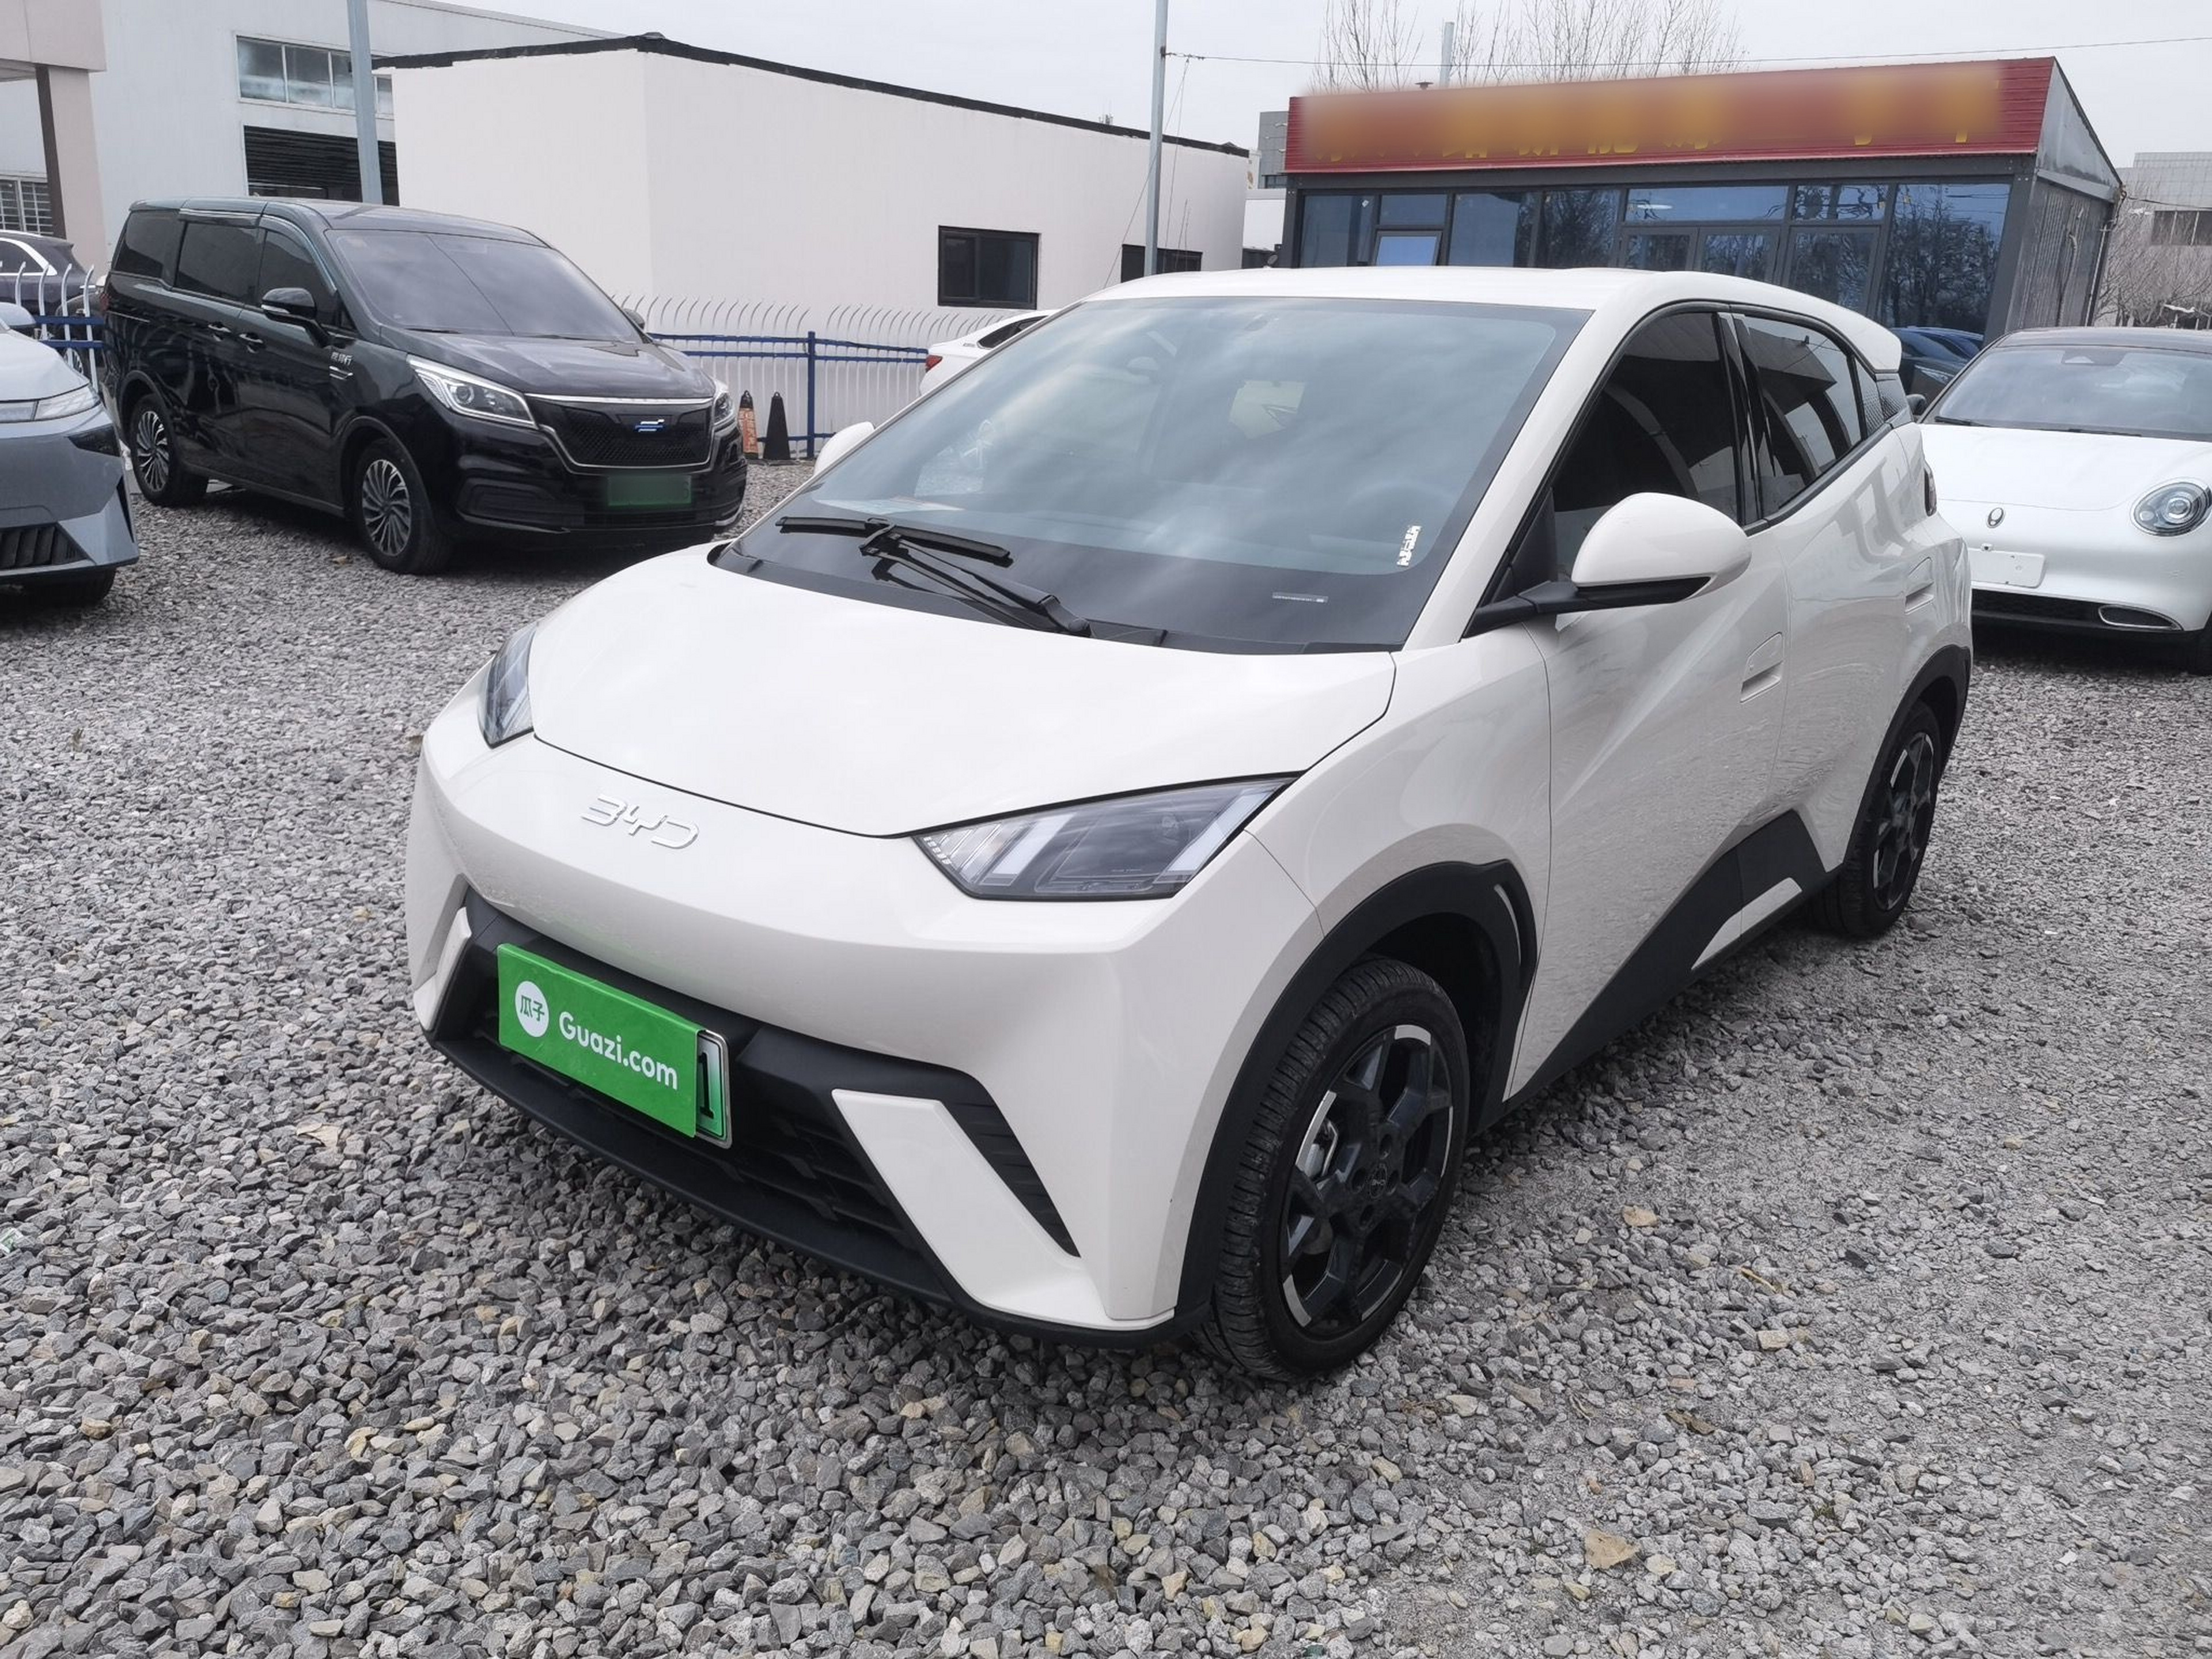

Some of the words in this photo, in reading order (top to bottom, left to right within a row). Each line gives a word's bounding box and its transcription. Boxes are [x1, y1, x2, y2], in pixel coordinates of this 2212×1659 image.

[580, 794, 699, 850] BYD
[520, 995, 545, 1022] 瓜子
[559, 1010, 678, 1091] Guazi.com
